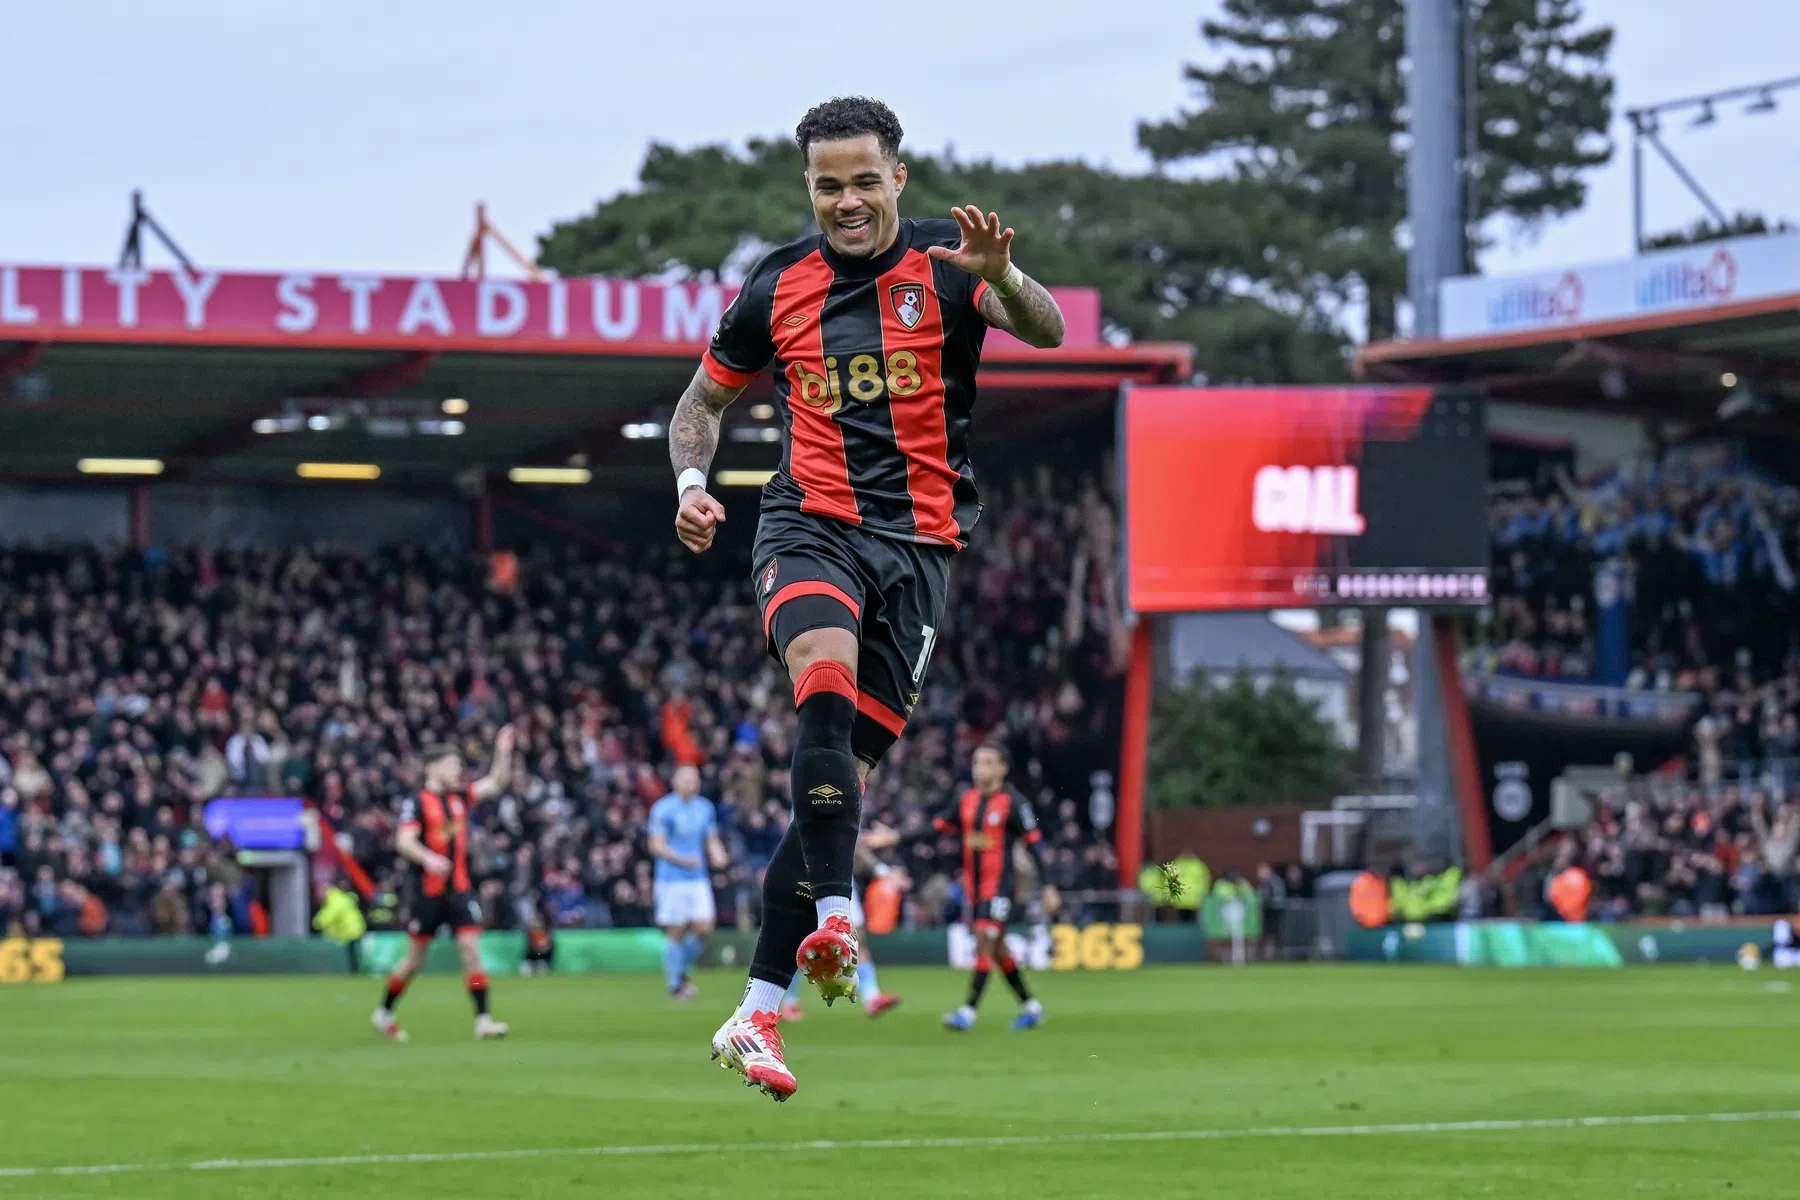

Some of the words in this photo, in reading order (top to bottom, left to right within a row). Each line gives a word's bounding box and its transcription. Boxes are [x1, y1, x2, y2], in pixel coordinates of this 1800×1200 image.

[275, 273, 722, 342] STADIUM
[794, 350, 922, 415] bj88
[1252, 464, 1367, 536] GOAL
